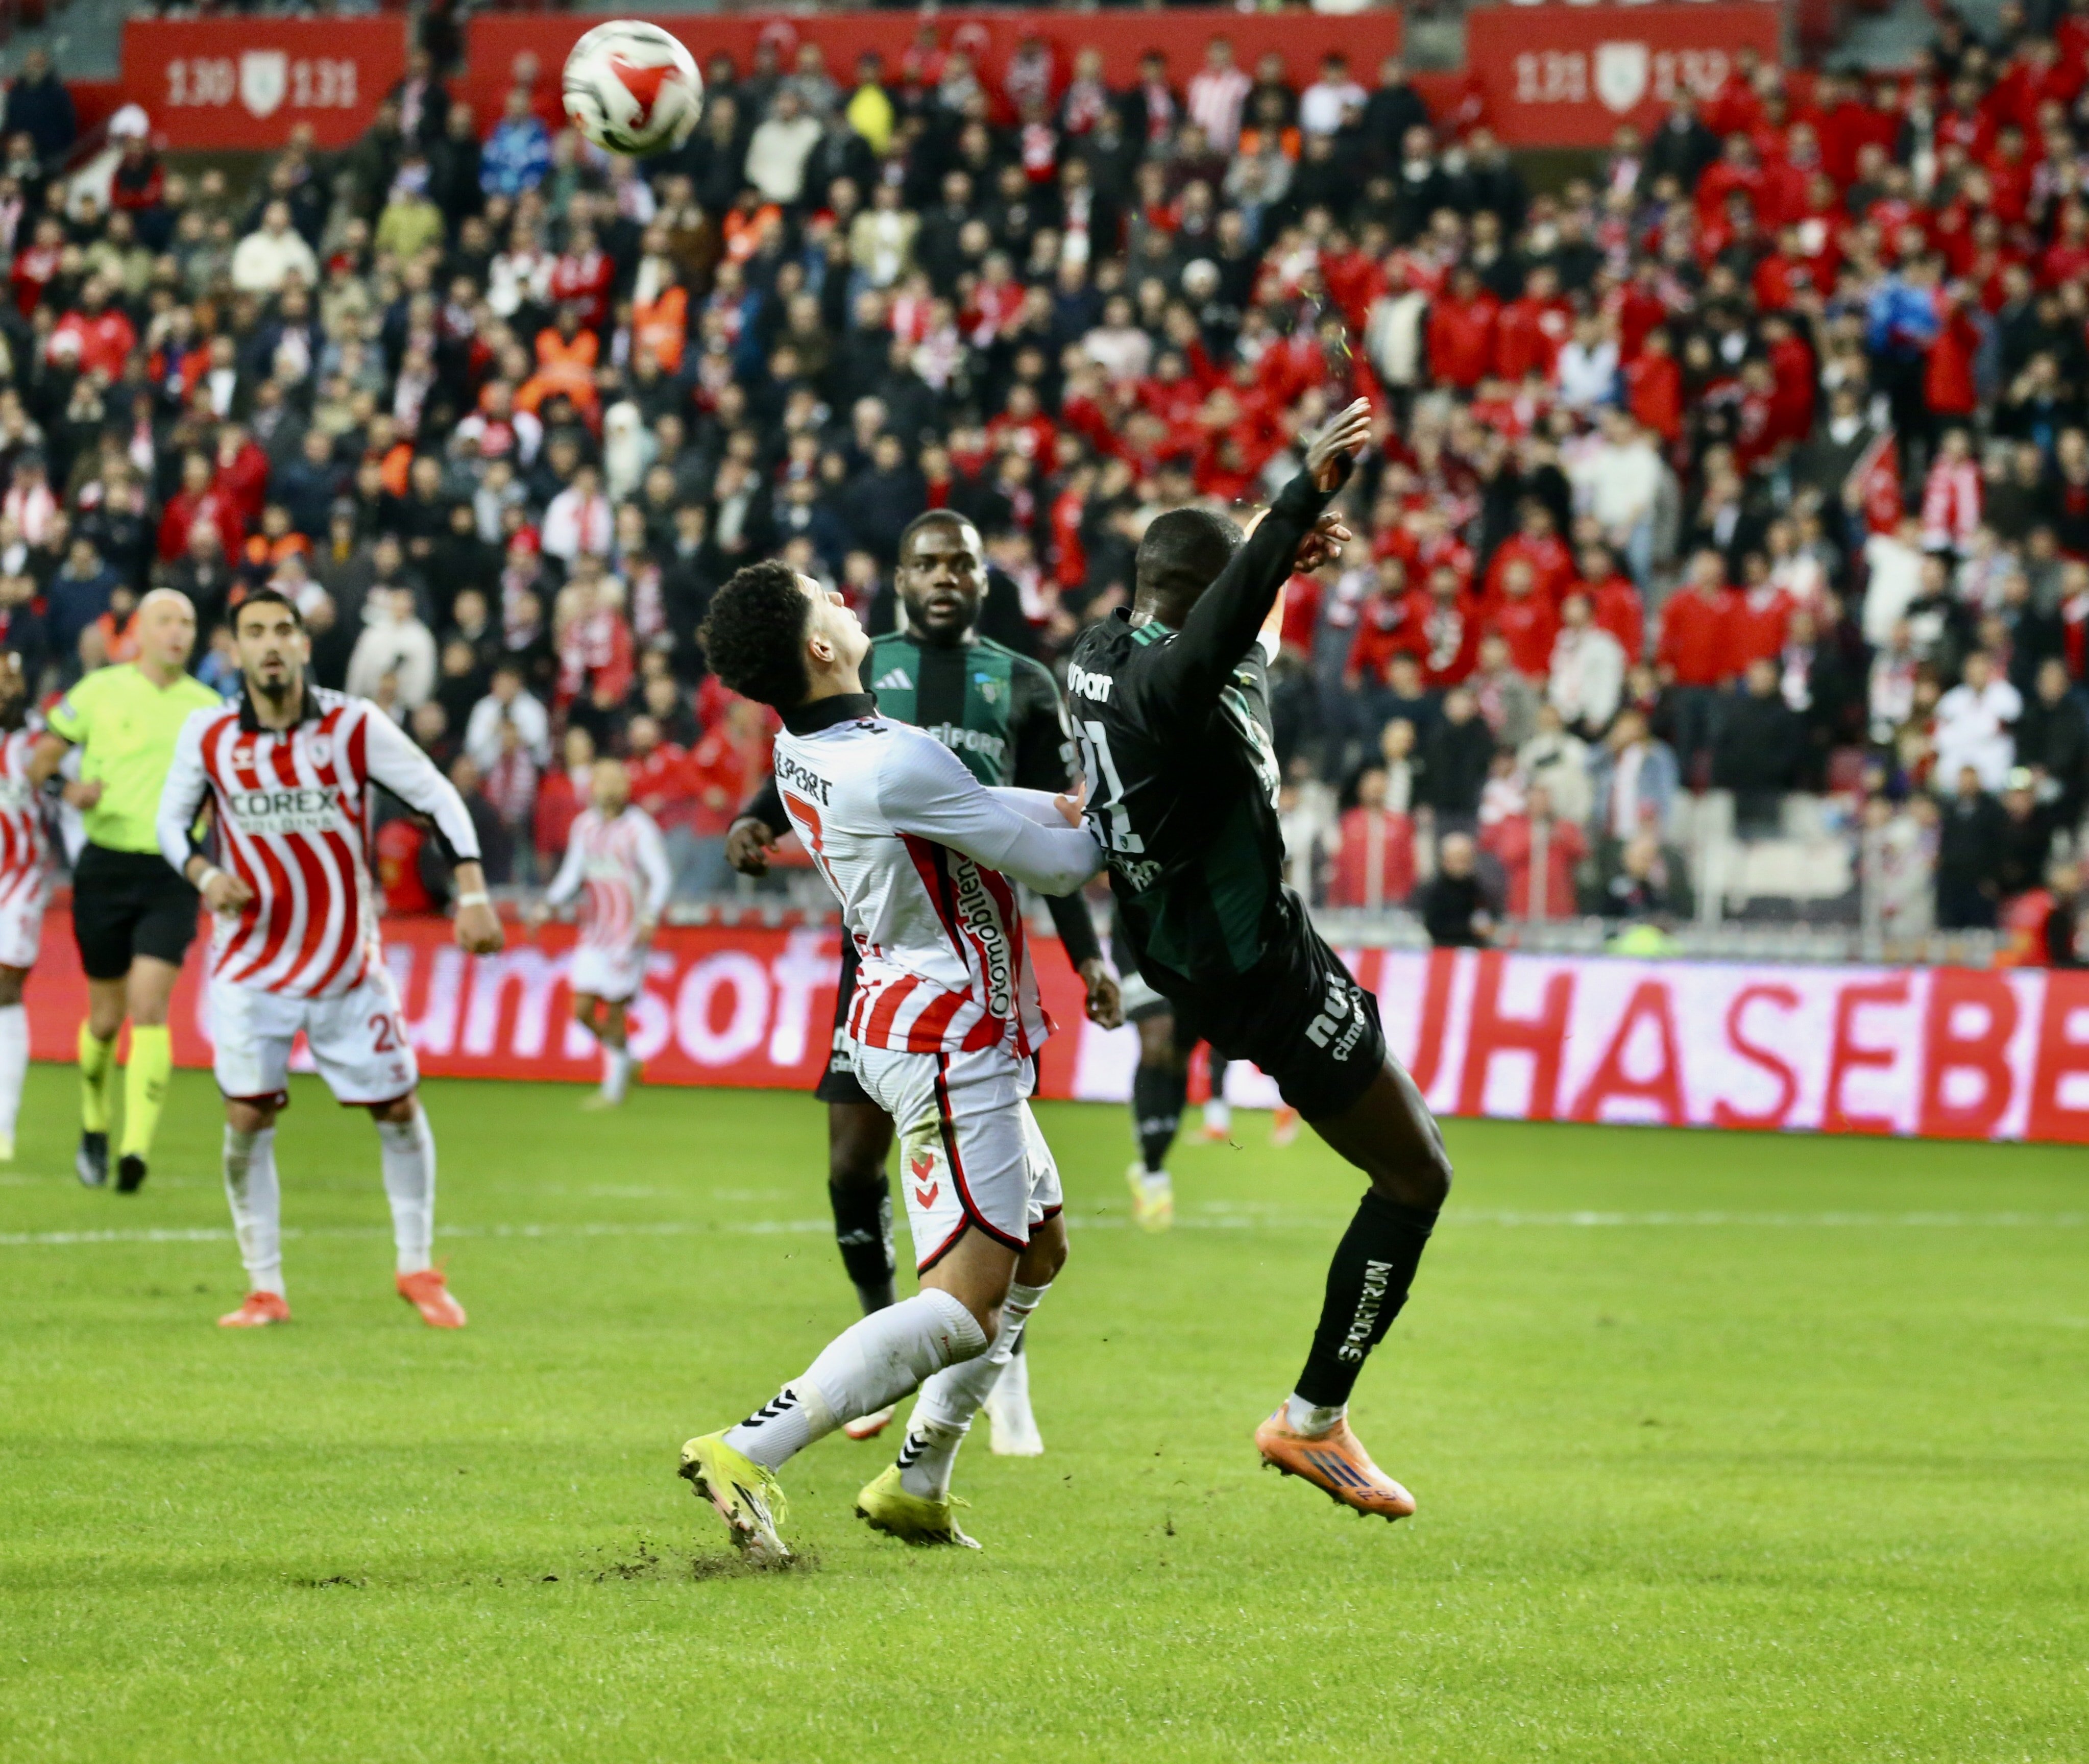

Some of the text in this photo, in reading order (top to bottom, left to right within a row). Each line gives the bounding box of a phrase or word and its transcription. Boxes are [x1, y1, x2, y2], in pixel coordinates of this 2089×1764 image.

[230, 788, 338, 818] COREX
[956, 860, 1009, 1016] Otomobilen
[1338, 1259, 1394, 1364] SPORTRUN
